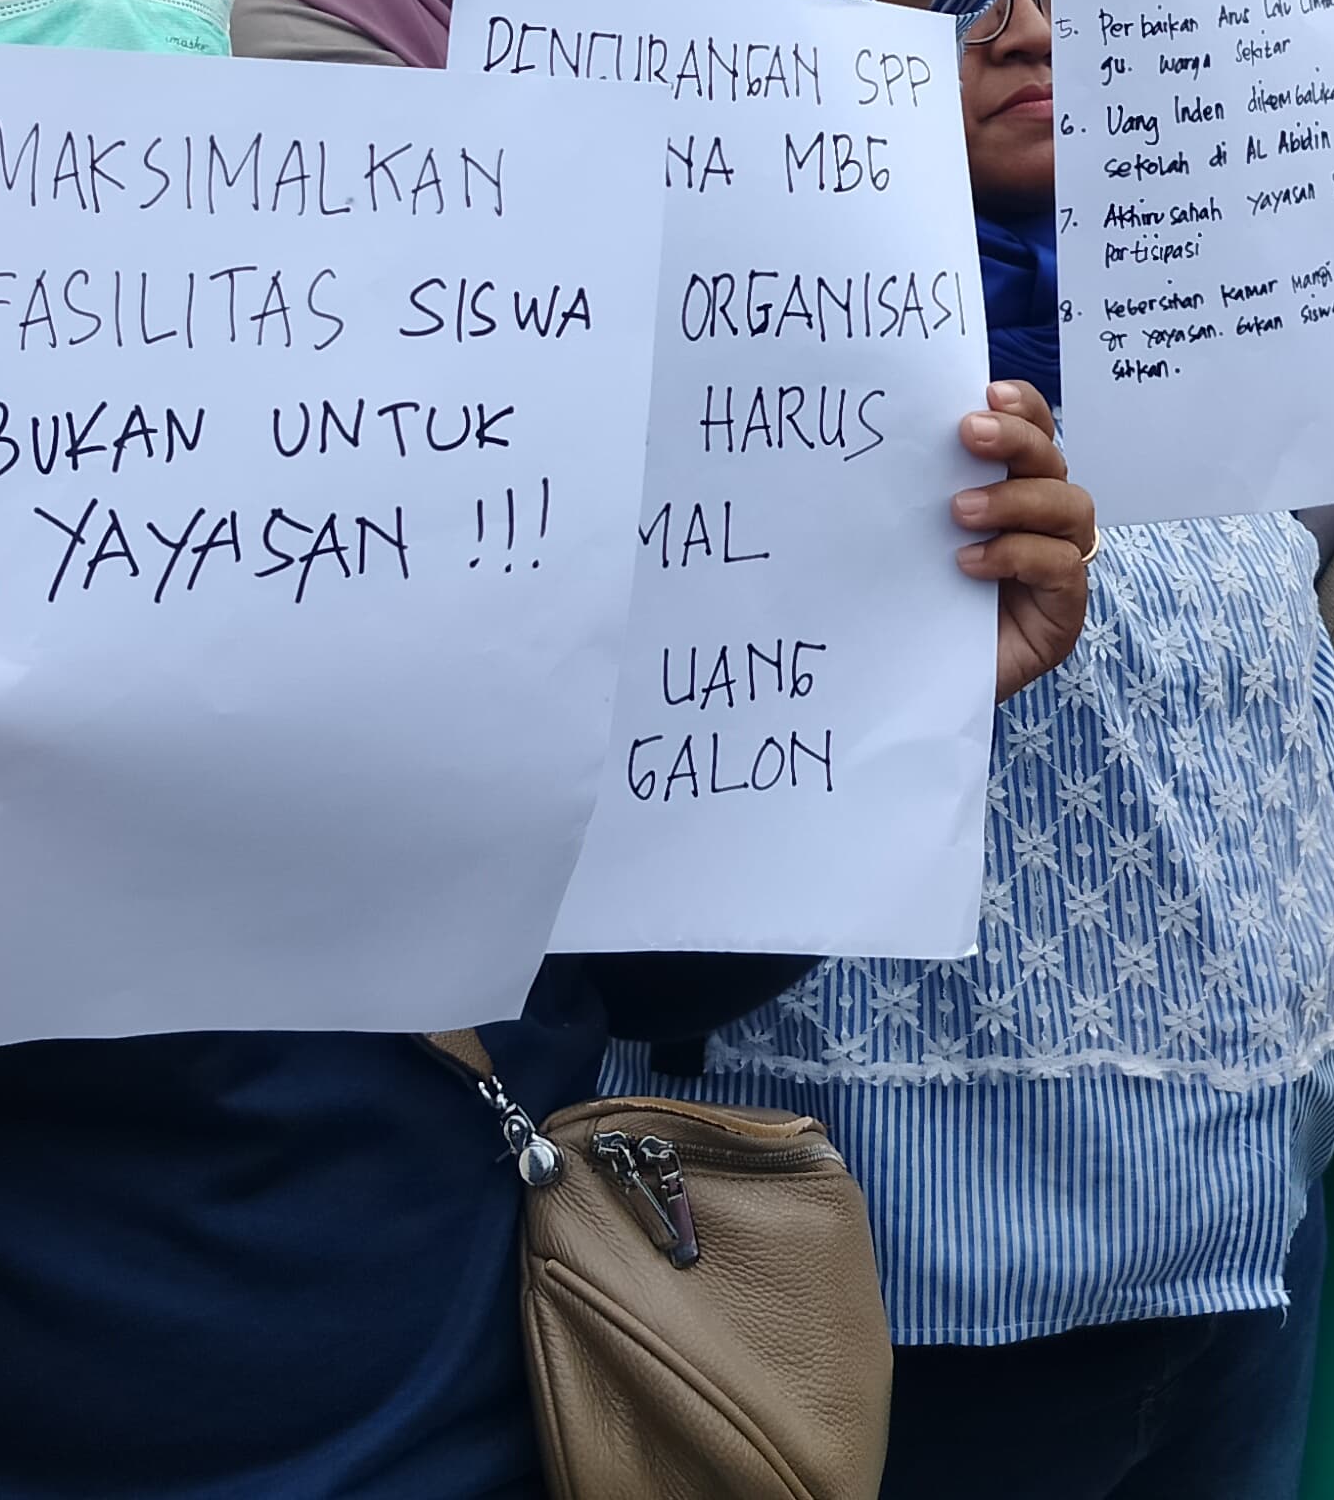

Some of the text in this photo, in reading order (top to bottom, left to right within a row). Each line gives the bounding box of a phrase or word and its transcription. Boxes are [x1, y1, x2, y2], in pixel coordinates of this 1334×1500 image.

[855, 48, 932, 107] SPP
[784, 131, 890, 193] MBG
[1209, 141, 1227, 167] di
[399, 278, 592, 343] SISWA
[681, 269, 967, 342] ORGANISASI
[271, 398, 515, 458] UNTUK
[700, 384, 886, 461] HARUS
[33, 498, 410, 604] YAYASAN
[663, 638, 827, 710] UANG
[627, 729, 834, 802] GALON
